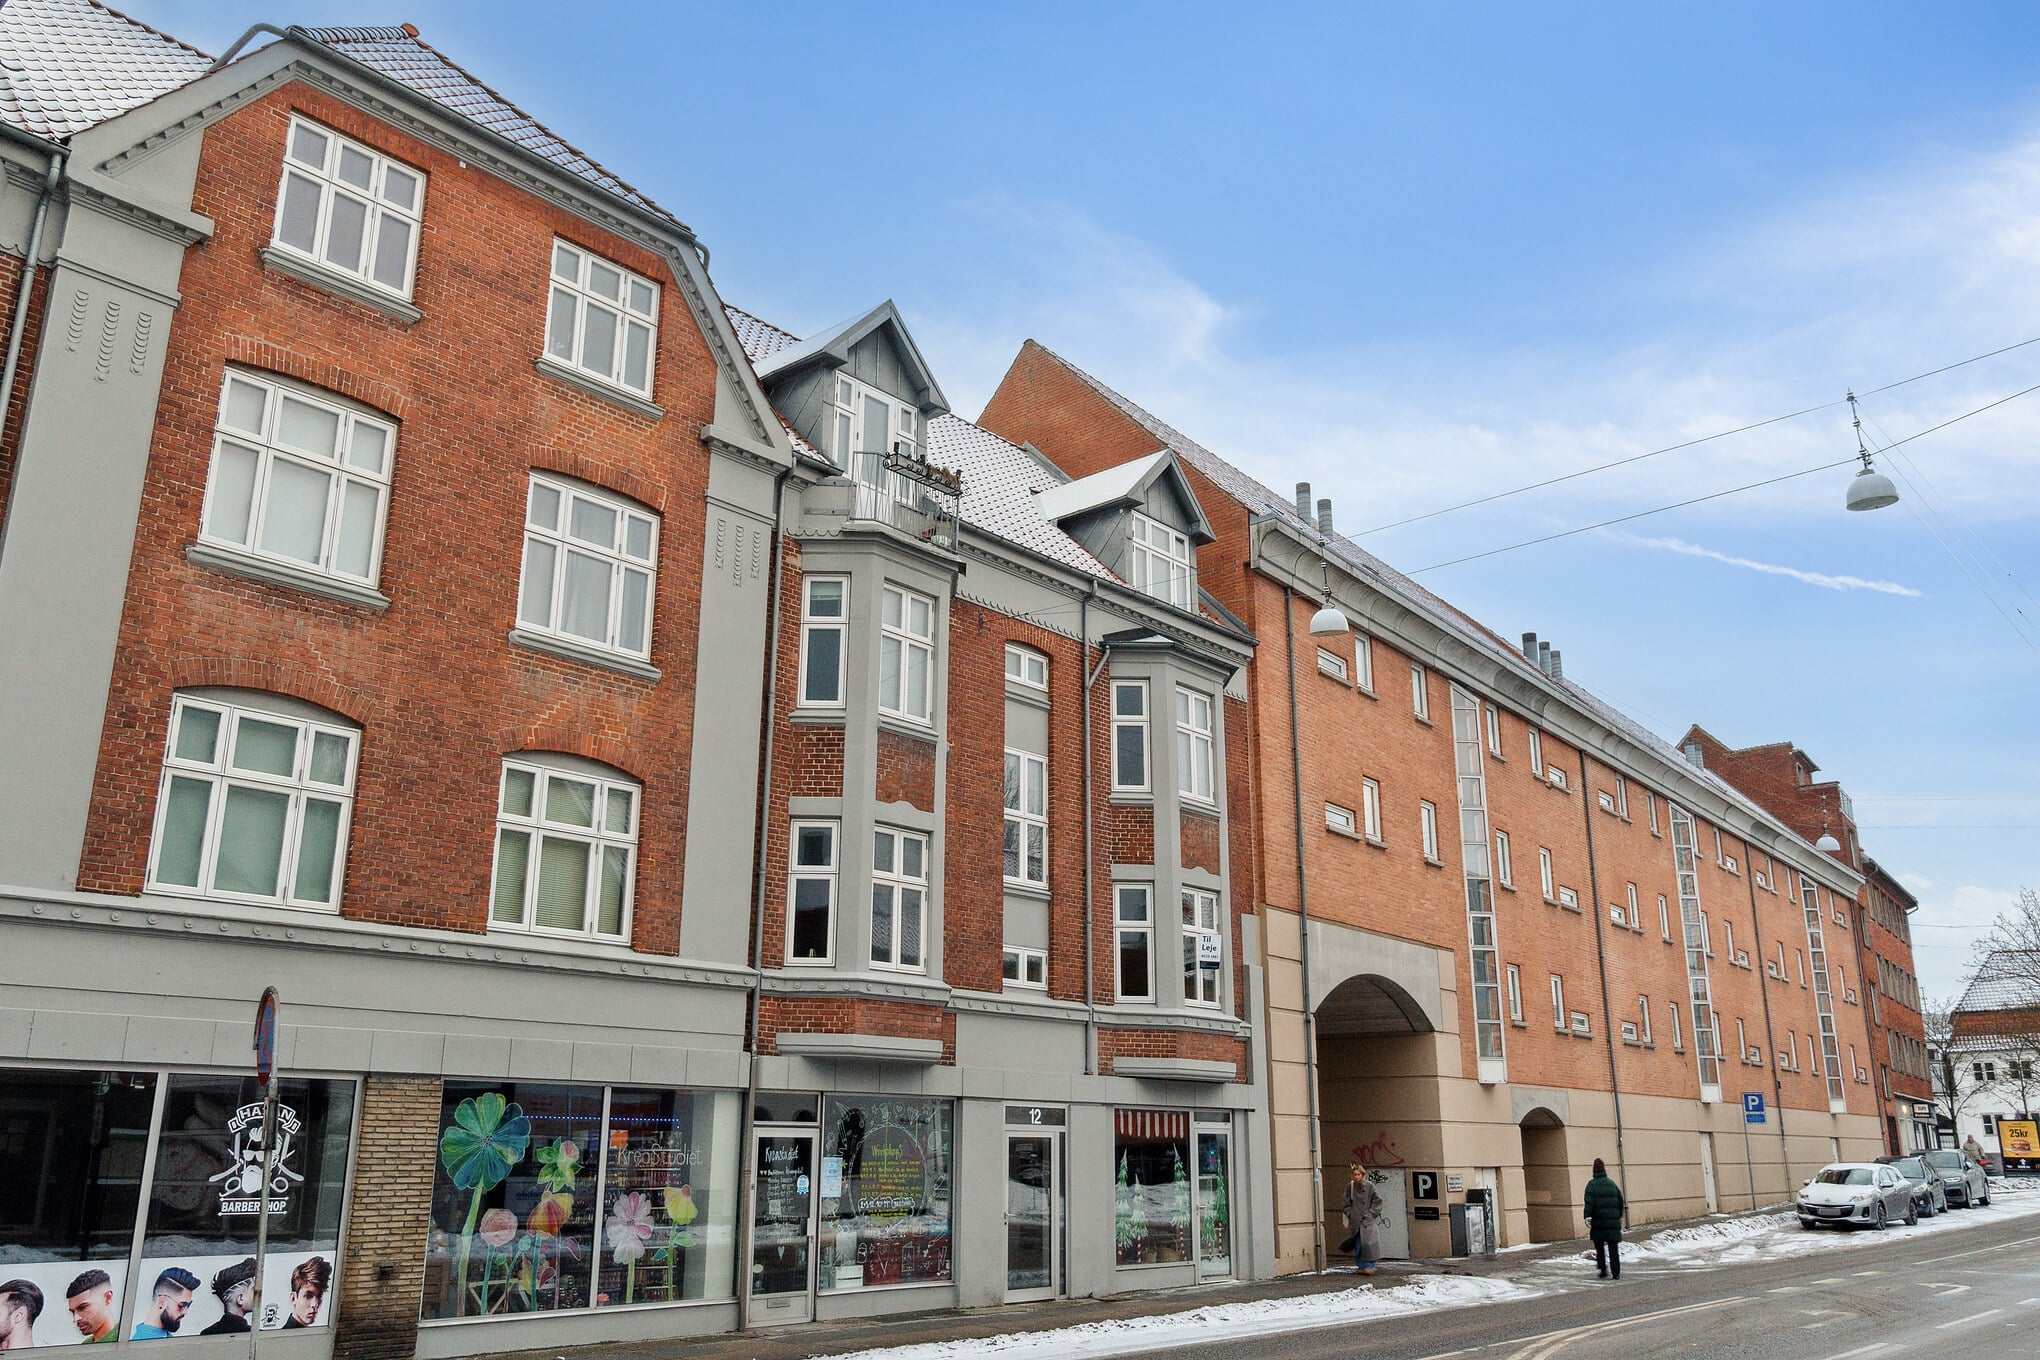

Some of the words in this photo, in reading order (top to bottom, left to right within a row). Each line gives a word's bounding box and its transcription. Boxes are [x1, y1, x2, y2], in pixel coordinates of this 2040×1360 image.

[1202, 935, 1212, 943] Til
[1201, 944, 1217, 953] Leje
[1747, 1095, 1760, 1111] P
[240, 1106, 294, 1121] HAN
[1029, 1108, 1042, 1125] 12
[1418, 1174, 1433, 1198] P
[221, 1201, 287, 1212] BARBERHOP
